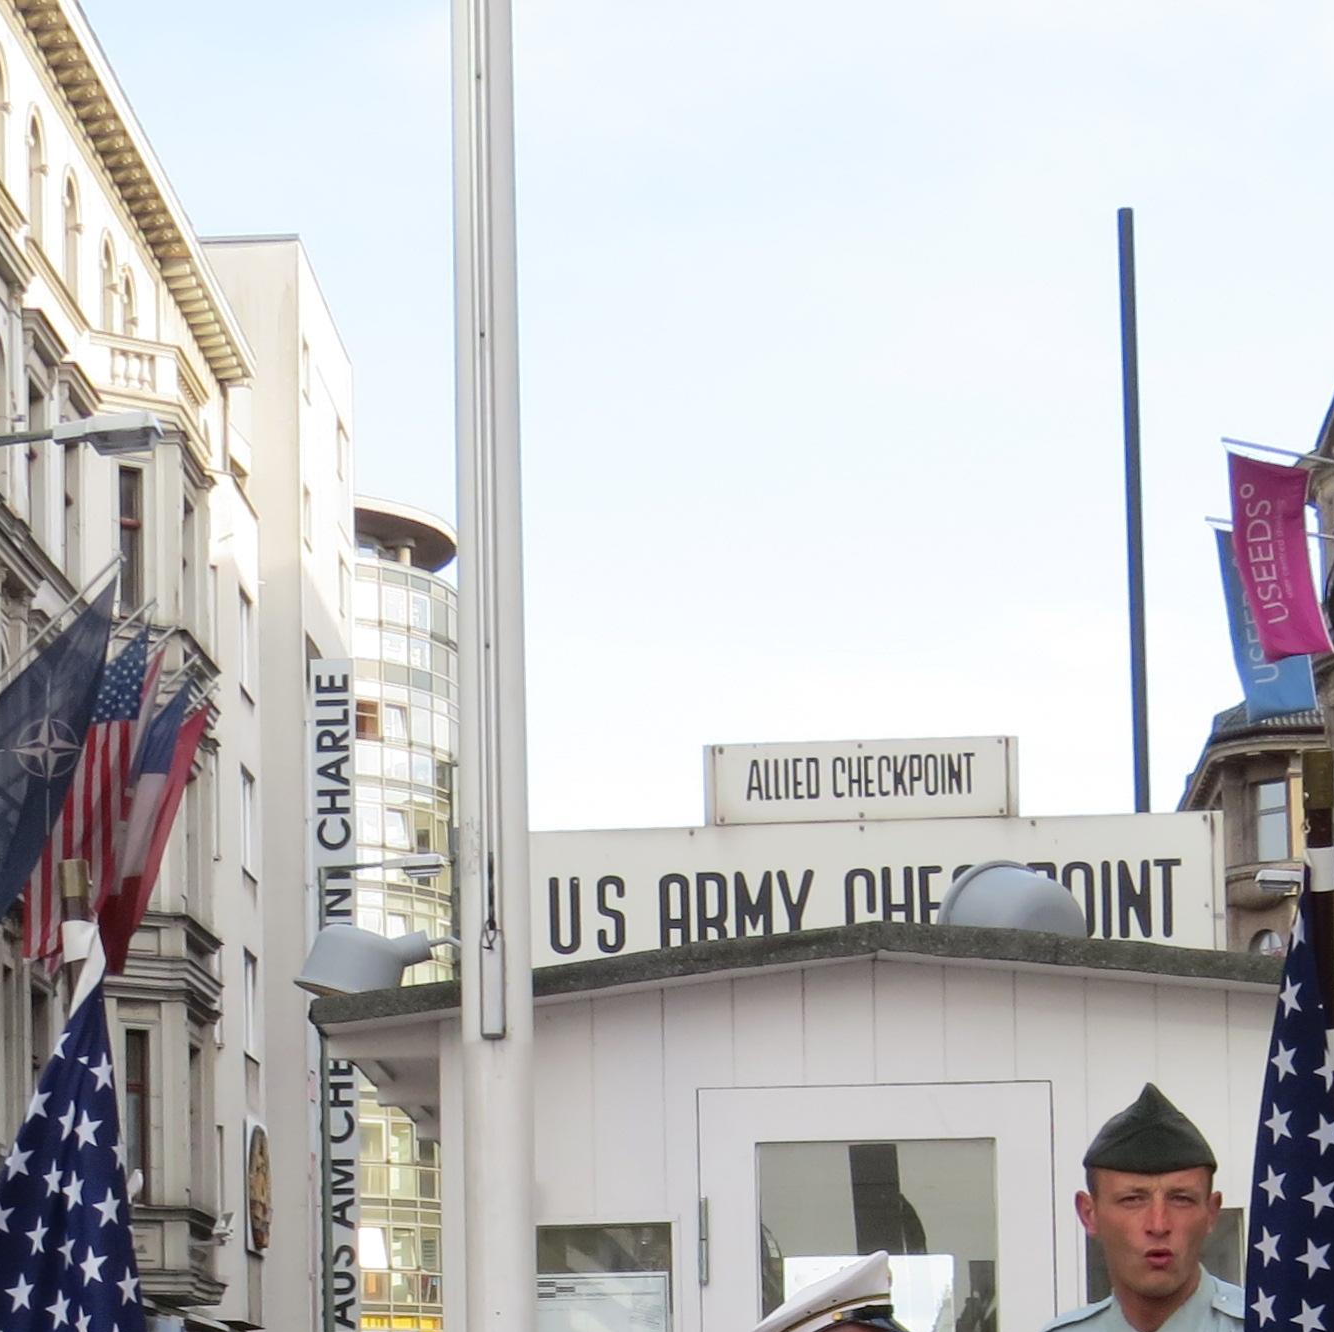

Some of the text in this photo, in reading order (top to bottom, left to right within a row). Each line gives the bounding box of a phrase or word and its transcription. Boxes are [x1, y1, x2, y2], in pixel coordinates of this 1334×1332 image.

[315, 673, 351, 850] CHARLIE
[746, 752, 975, 801] ALLIED CHECKPOINT
[548, 858, 1182, 955] US ARMY CHEOINT
[327, 1158, 355, 1230] AM
